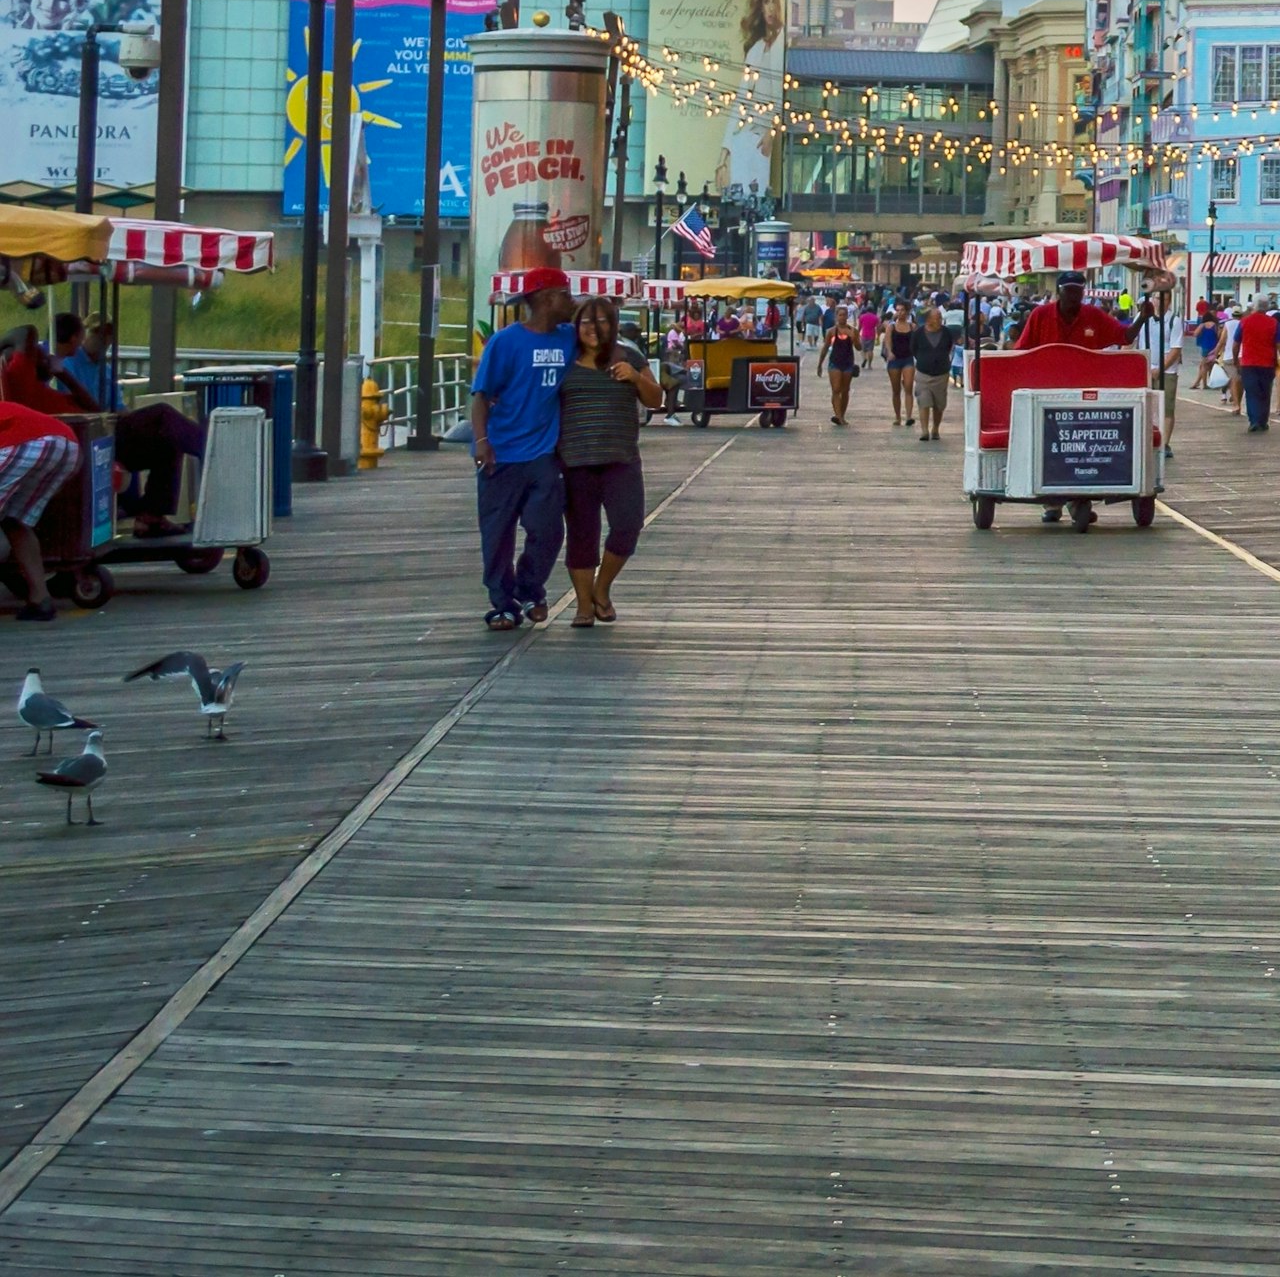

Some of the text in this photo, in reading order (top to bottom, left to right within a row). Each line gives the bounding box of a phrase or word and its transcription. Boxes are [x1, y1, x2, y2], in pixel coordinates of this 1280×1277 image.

[446, 37, 467, 48] GIV
[395, 50, 423, 61] YOU
[387, 63, 411, 74] ALL
[481, 139, 575, 173] COME IN
[484, 157, 585, 197] PEACH.
[533, 349, 564, 363] GIANTS
[541, 368, 557, 386] 10
[755, 373, 791, 384] Hard Rock
[1055, 411, 1123, 421] DOS CAMINOS
[1059, 429, 1119, 441] $5 APPETIZER
[1051, 440, 1126, 457] & DRINK specials
